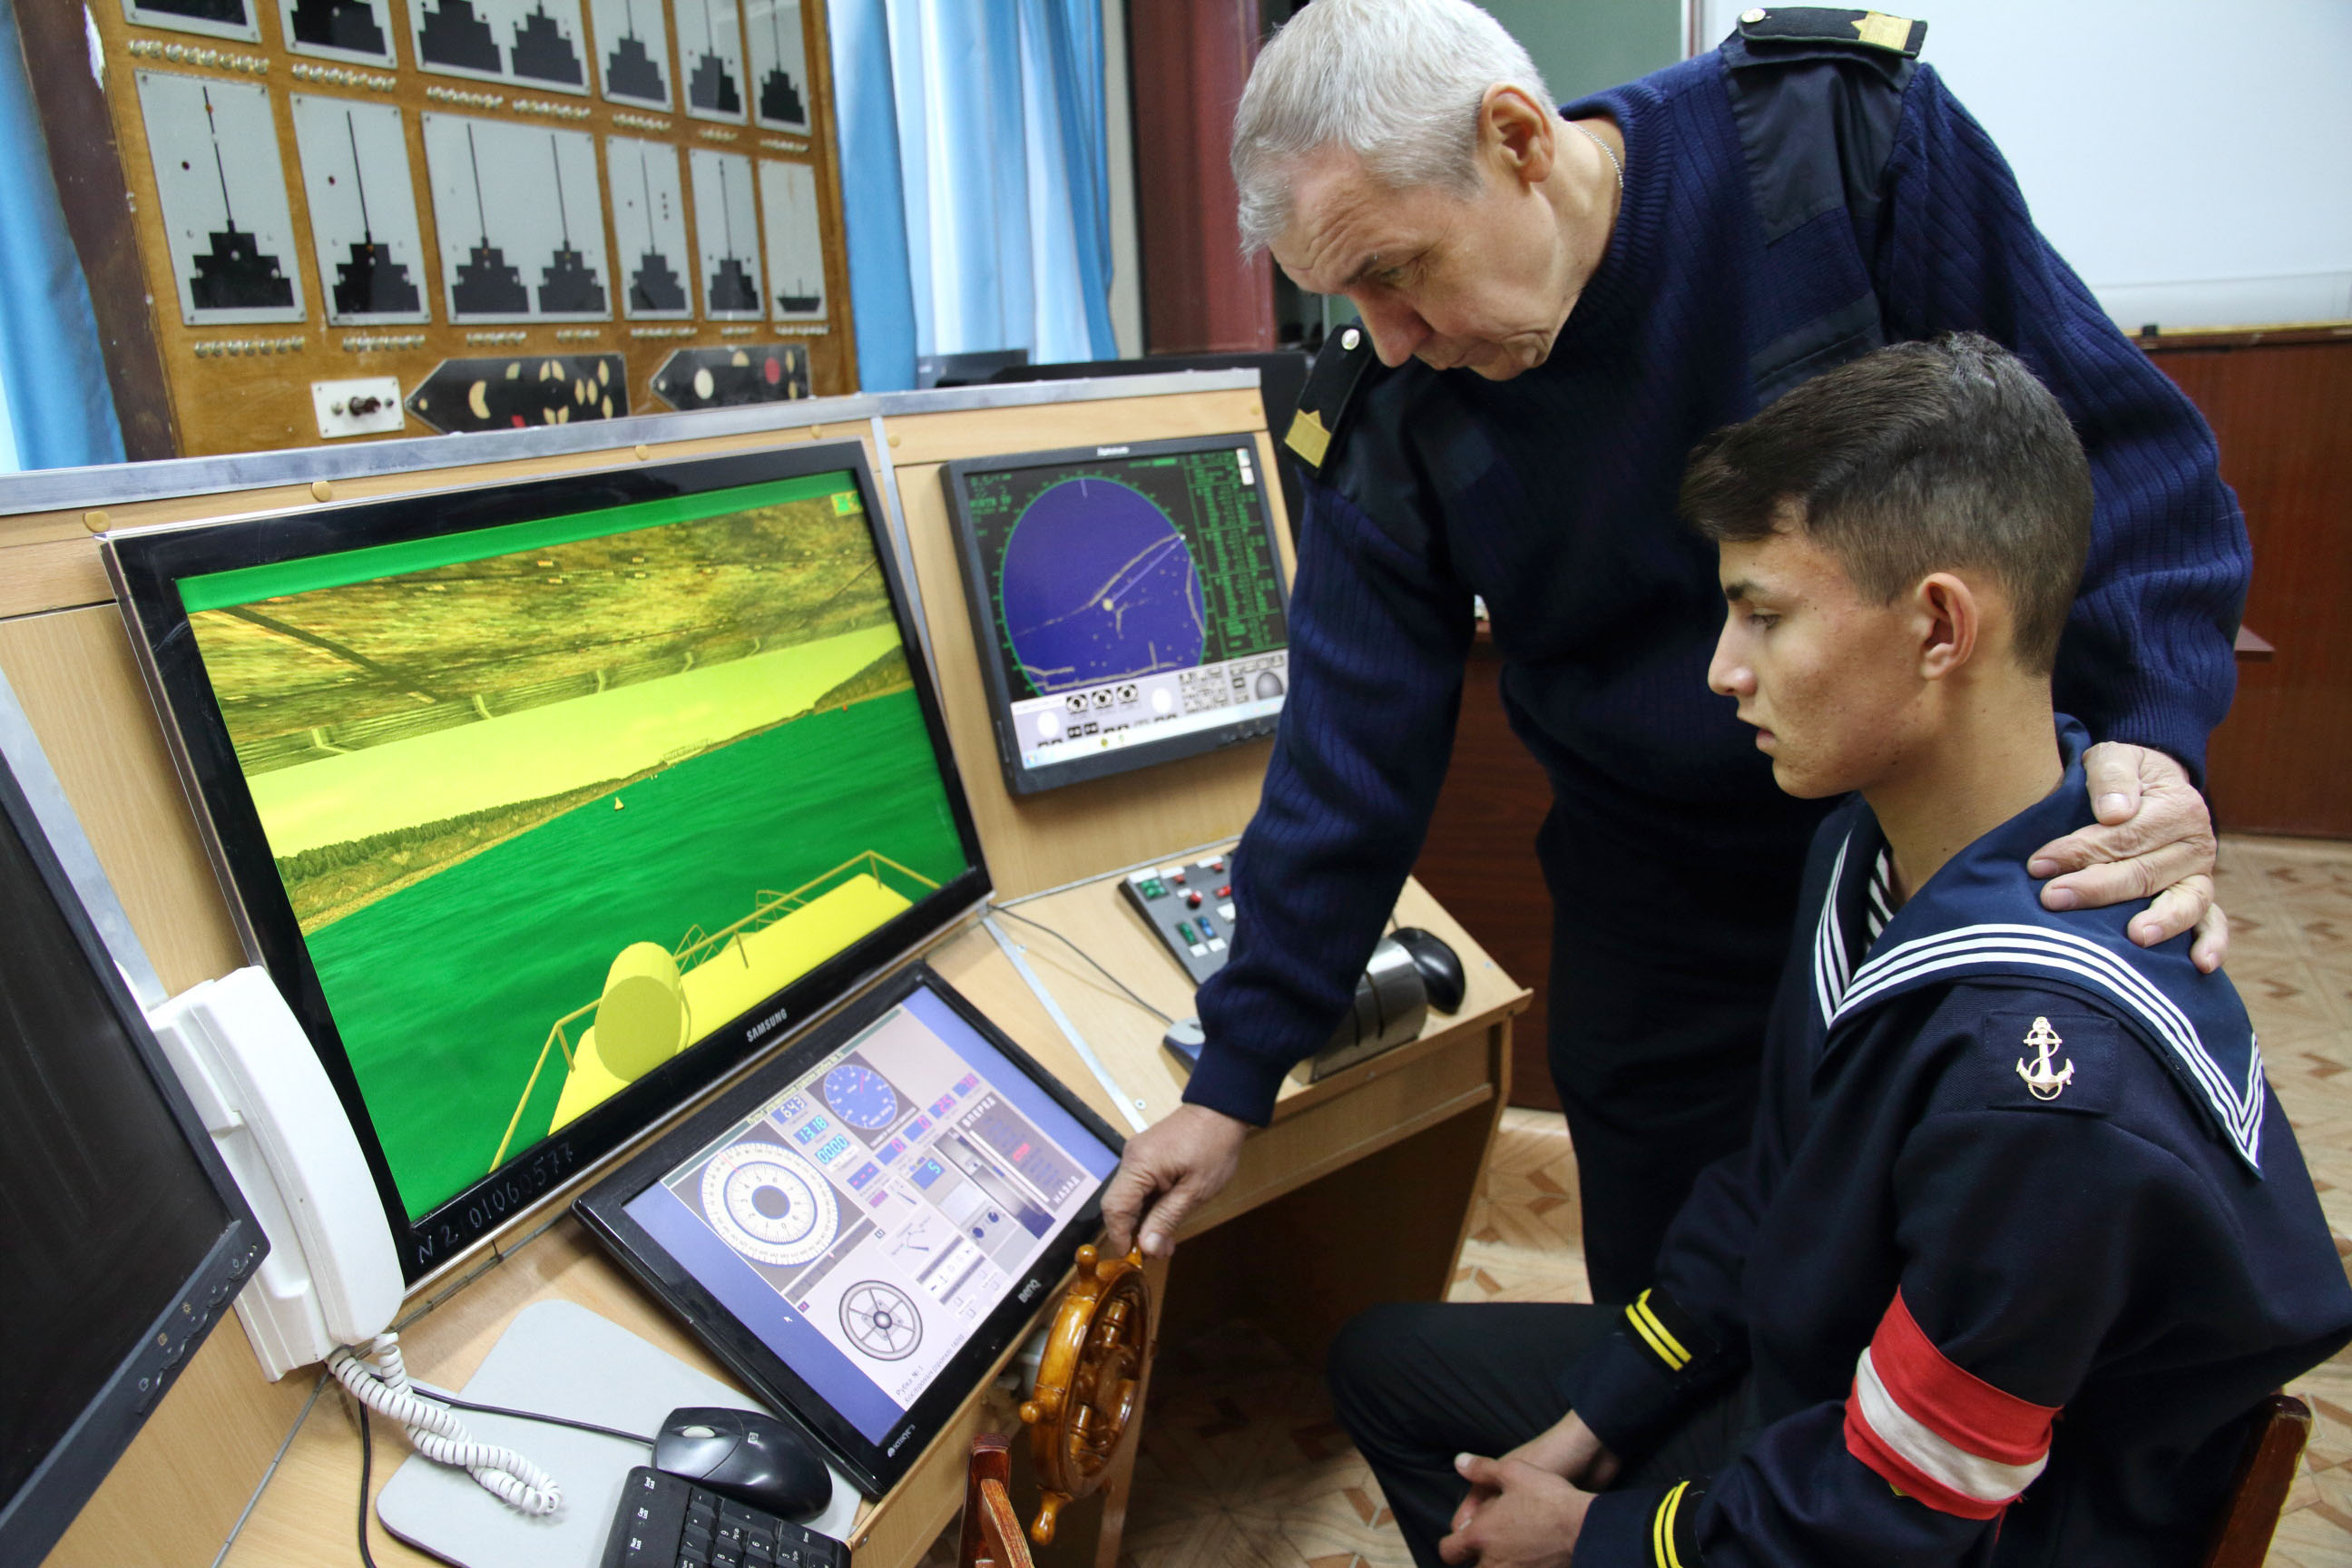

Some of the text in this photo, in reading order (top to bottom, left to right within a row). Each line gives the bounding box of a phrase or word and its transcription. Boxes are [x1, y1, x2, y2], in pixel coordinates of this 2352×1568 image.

[746, 1007, 788, 1043] SAMSUNG
[961, 1096, 996, 1128] ВПЕРЕД
[926, 1160, 941, 1176] 5
[1053, 1176, 1080, 1204] НАЗАД
